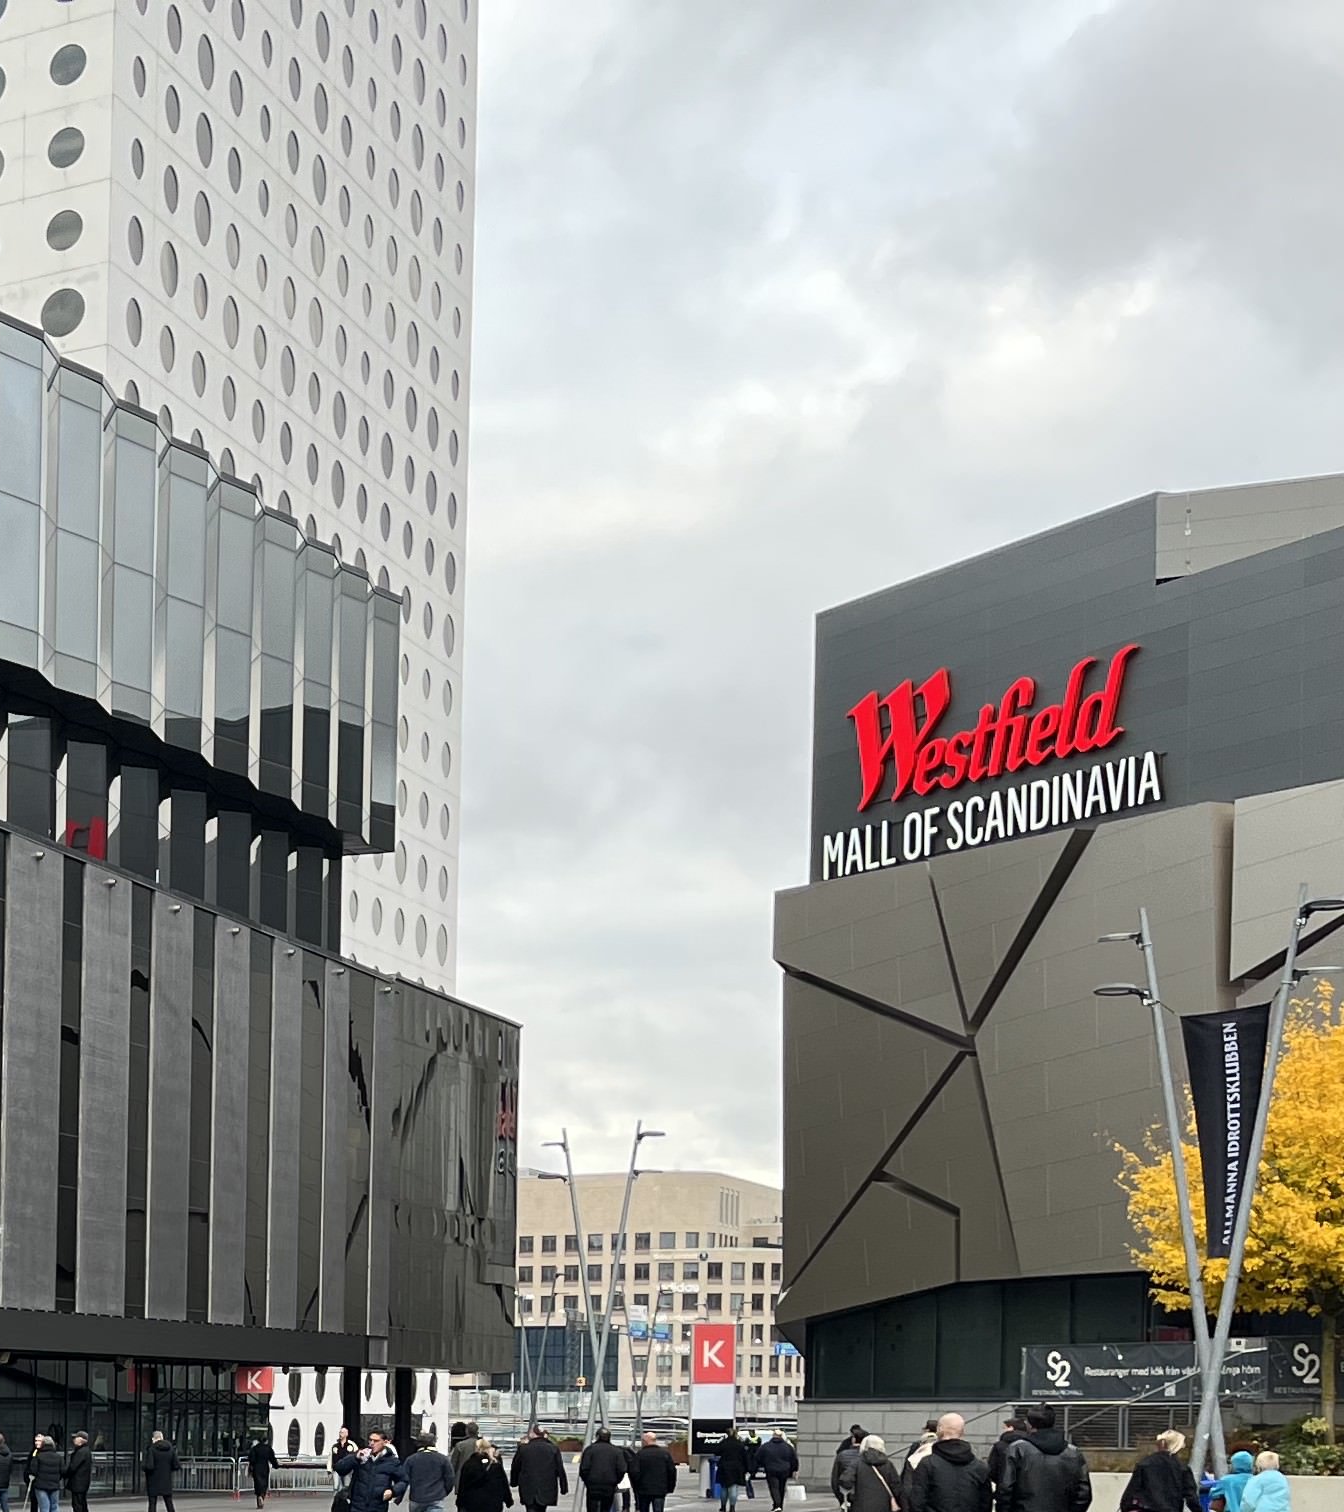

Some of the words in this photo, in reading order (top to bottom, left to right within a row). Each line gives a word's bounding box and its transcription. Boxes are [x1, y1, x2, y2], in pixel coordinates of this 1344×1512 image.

[846, 643, 1140, 812] Westfield
[822, 820, 897, 881] MALL
[903, 808, 941, 858] OF
[946, 751, 1162, 850] SCANDINAVIA
[1222, 1022, 1241, 1158] IDROTTSKLUBBEN
[703, 1340, 725, 1368] K
[1046, 1351, 1071, 1387] S2
[1292, 1343, 1320, 1384] S2
[247, 1370, 262, 1390] K
